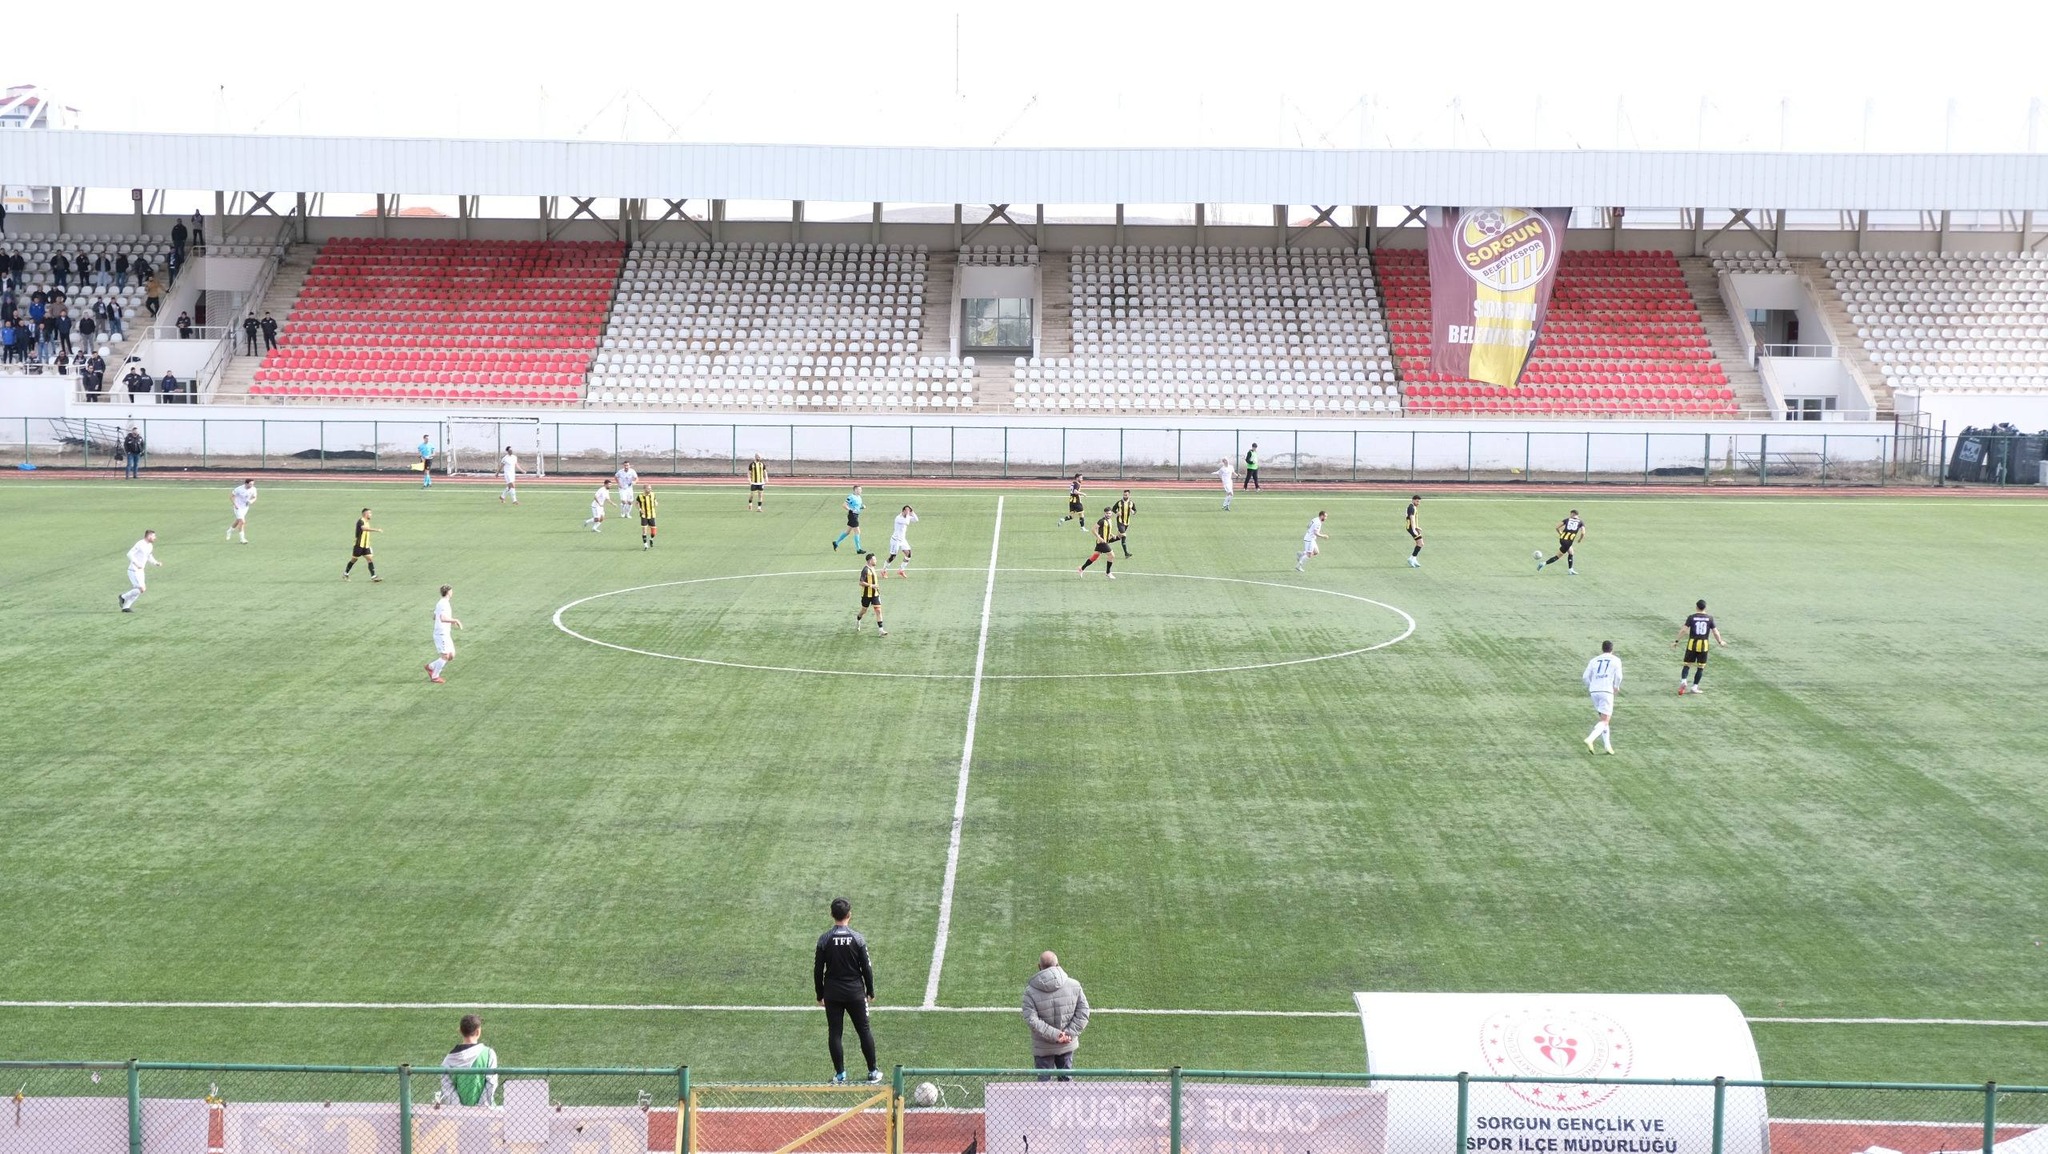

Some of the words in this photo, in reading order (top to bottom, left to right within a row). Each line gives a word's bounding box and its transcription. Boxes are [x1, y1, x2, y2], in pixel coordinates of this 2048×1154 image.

[1466, 221, 1543, 266] SORGUN
[1482, 242, 1541, 277] BELEDİYESPOR
[1597, 659, 1611, 674] 77
[832, 936, 853, 945] TFF
[1477, 1116, 1551, 1131] SORGUN
[1557, 1116, 1636, 1134] GENÇLİK
[1641, 1119, 1665, 1132] VE
[1466, 1137, 1513, 1151] SPOR
[1519, 1135, 1557, 1154] İLÇE
[1564, 1135, 1678, 1153] MÜDÜRLÜĞÜ
